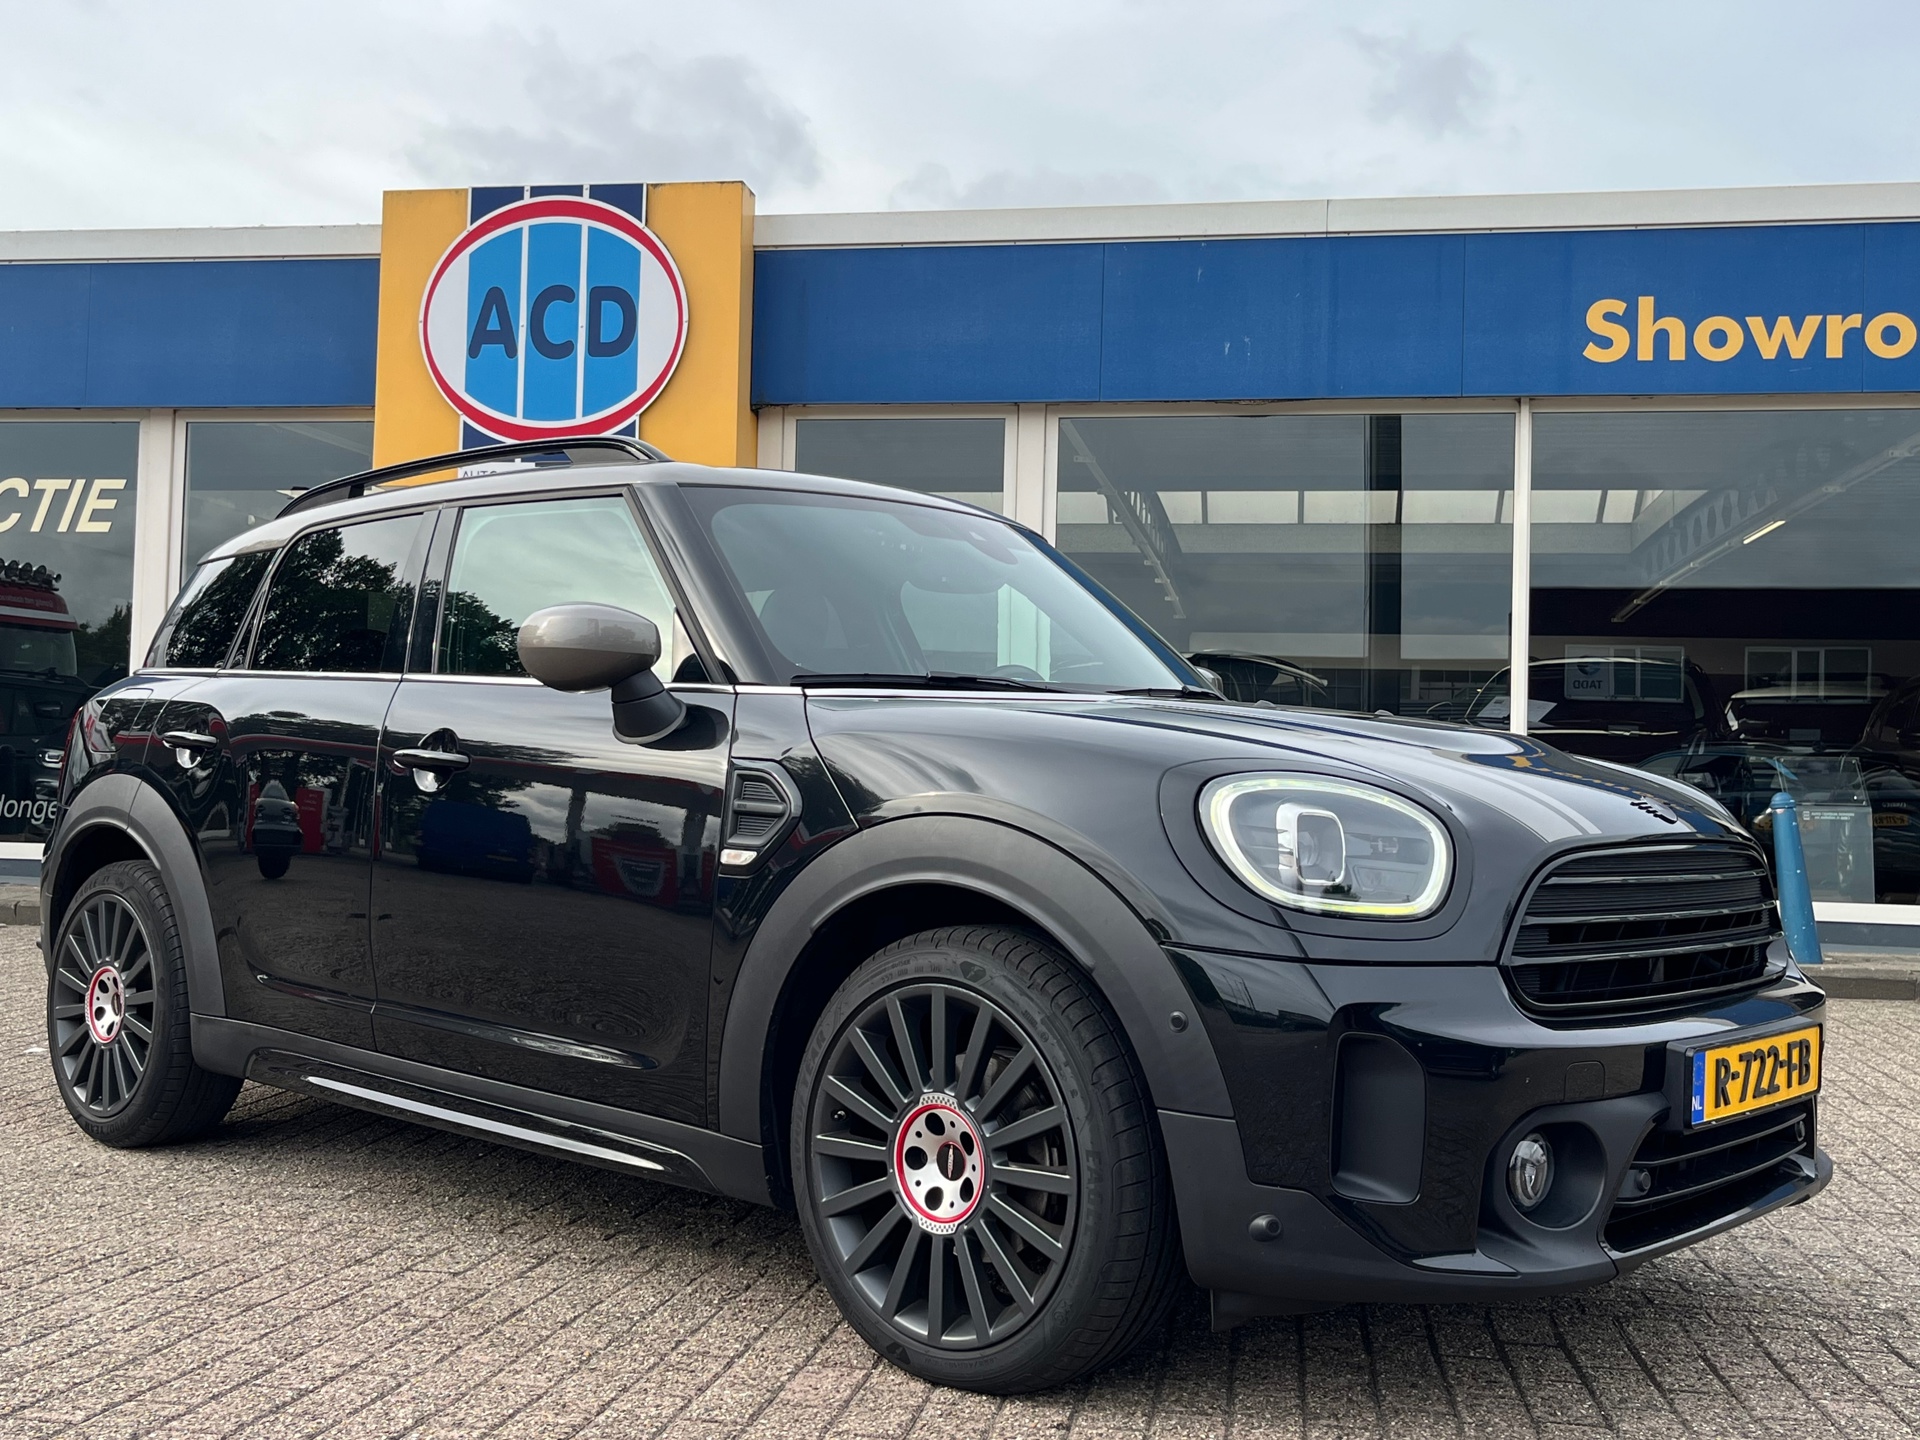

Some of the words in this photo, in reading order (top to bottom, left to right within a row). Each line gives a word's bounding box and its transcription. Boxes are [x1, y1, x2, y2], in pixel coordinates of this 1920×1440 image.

[467, 283, 637, 361] ACD
[1582, 295, 1918, 363] Showro
[0, 477, 127, 533] CTIE
[0, 794, 58, 825] onge
[1692, 1095, 1702, 1111] NL
[1714, 1038, 1811, 1109] R-722-FB
